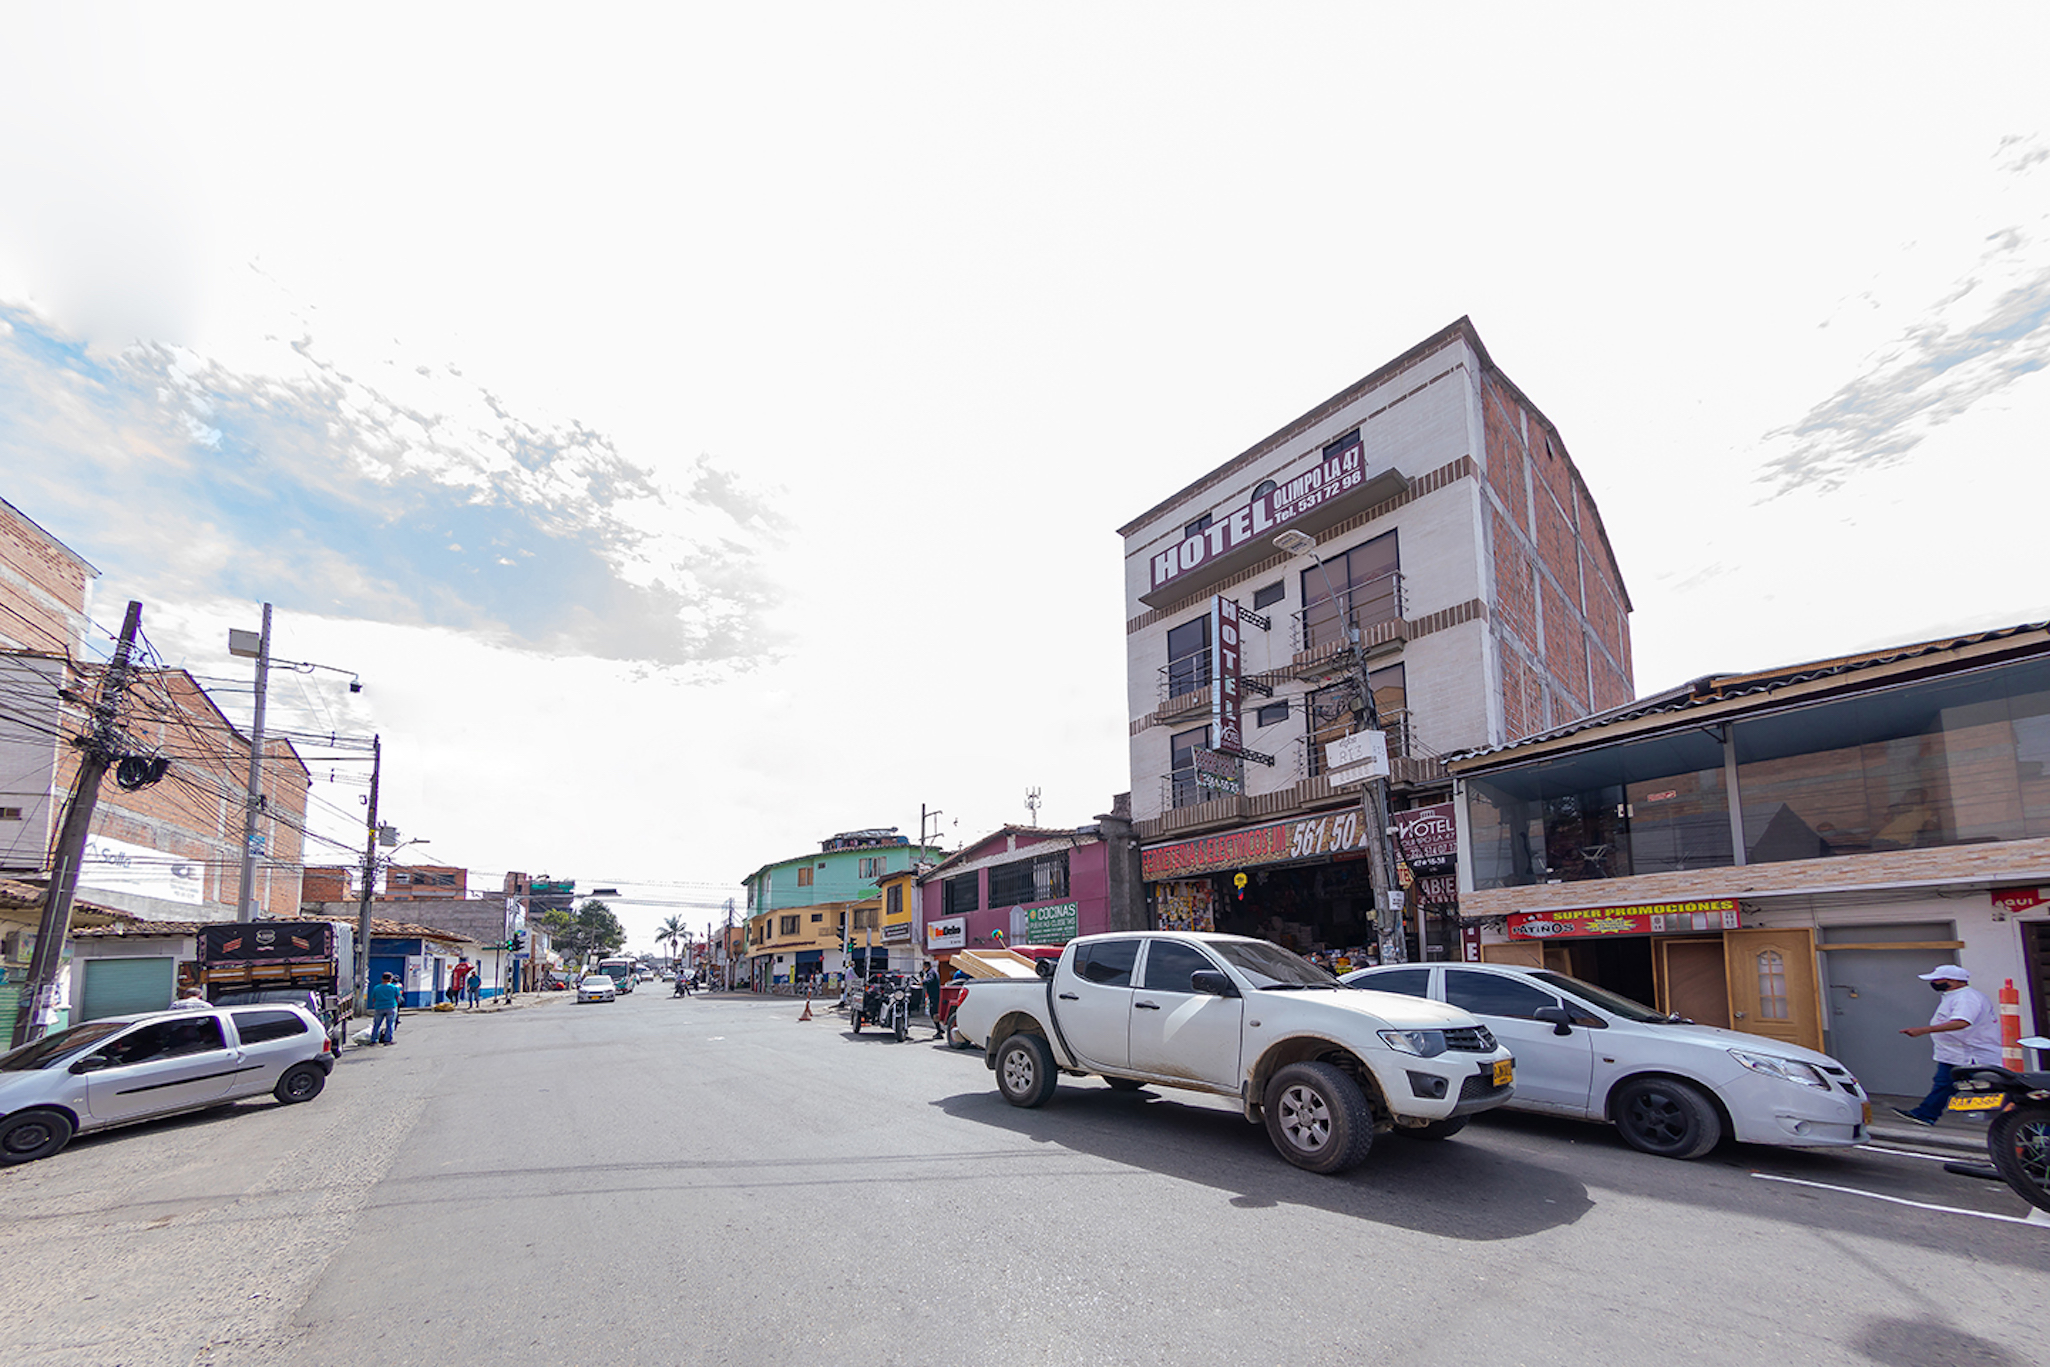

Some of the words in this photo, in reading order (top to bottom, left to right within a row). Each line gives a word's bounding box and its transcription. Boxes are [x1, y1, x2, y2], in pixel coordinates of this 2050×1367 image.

[1273, 467, 1322, 509] OLIMPO
[1324, 457, 1341, 483] LA
[1343, 446, 1359, 471] 47
[1274, 505, 1297, 524] Tel.
[1298, 491, 1322, 512] 531
[1323, 481, 1340, 499] 72
[1341, 470, 1361, 489] 98
[1155, 497, 1273, 585] HOTEL
[1220, 598, 1237, 721] HOTEL
[1143, 842, 1196, 874] FERRETERIA
[1207, 828, 1268, 863] ELECTRICOS
[1270, 824, 1286, 853] JM
[1290, 817, 1328, 858] 561
[1329, 812, 1356, 852] 50
[1399, 819, 1455, 839] HOTEL
[1037, 903, 1076, 921] COCINAS
[1552, 911, 1602, 922] SUPER
